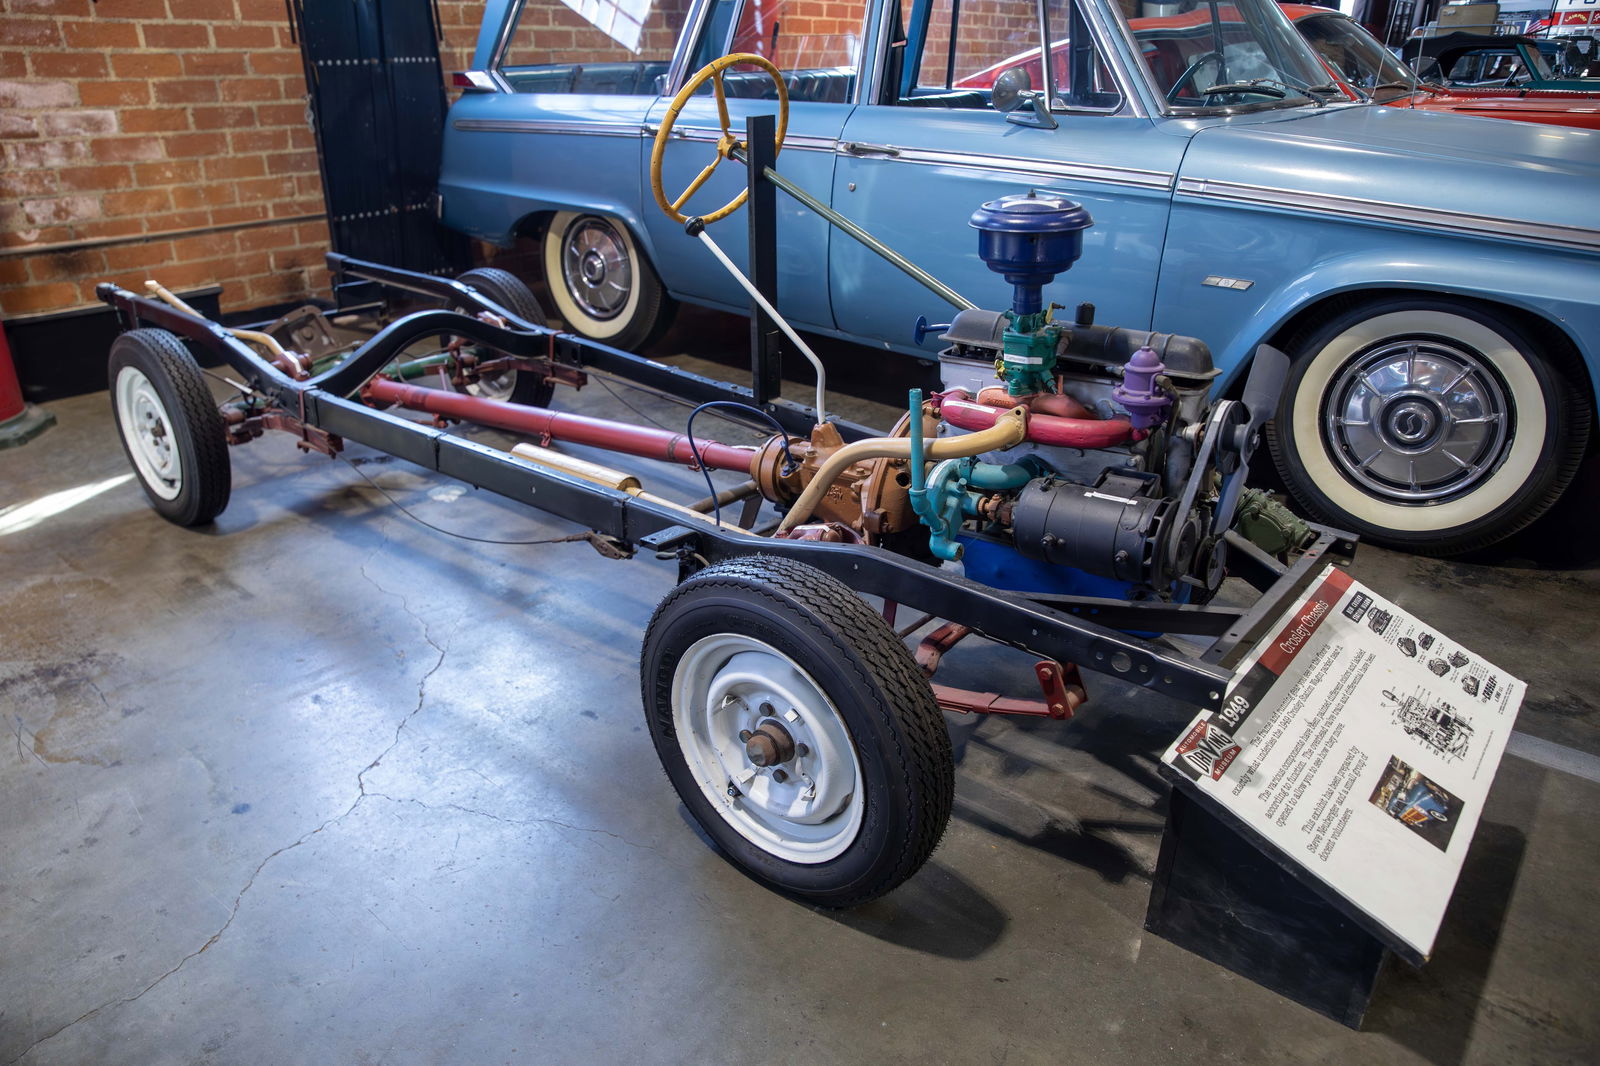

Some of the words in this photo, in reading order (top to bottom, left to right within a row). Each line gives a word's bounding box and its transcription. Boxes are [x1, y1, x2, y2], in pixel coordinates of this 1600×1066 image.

[1279, 623, 1310, 653] Crosley
[1300, 599, 1328, 627] Chassis
[1311, 656, 1321, 665] the
[1315, 647, 1327, 659] floor
[1351, 648, 1366, 664] labeled
[1302, 668, 1311, 678] see
[1347, 661, 1357, 672] and
[1296, 676, 1307, 687] you
[1339, 669, 1352, 684] colors
[1289, 683, 1300, 697] gear
[1326, 681, 1343, 701] different
[1276, 692, 1295, 714] running
[1316, 698, 1332, 720] painted
[1218, 695, 1250, 728] 1949
[1269, 710, 1280, 723] and
[1231, 773, 1251, 796] exactly
[1246, 759, 1260, 775] what
[1256, 736, 1277, 761] underlies
[1272, 728, 1283, 739] the
[1278, 715, 1291, 730] 1949
[1286, 699, 1304, 718] Crosley
[1298, 684, 1315, 702] Station
[1309, 671, 1324, 686] Wagon
[1320, 656, 1334, 674] parked
[1329, 648, 1340, 660] near
[1256, 721, 1273, 738] frame
[1306, 716, 1320, 729] been
[1179, 722, 1206, 752] AUTOMOBILE
[1249, 736, 1262, 747] The
[1264, 787, 1289, 819] according
[1301, 748, 1314, 759] The
[1309, 725, 1328, 750] overhead
[1323, 714, 1336, 727] valve
[1331, 702, 1344, 715] train
[1339, 692, 1349, 704] and
[1344, 670, 1364, 695] differential
[1358, 661, 1370, 673] have
[1365, 653, 1376, 664] been
[1298, 727, 1313, 742] have
[1324, 734, 1338, 748] they
[1186, 727, 1233, 774] DRIVING
[1281, 739, 1305, 770] components
[1317, 746, 1329, 759] how
[1214, 749, 1237, 775] MUSEUM
[1313, 757, 1323, 768] see
[1336, 751, 1355, 778] prepared
[1267, 767, 1285, 790] various
[1302, 771, 1314, 786] you
[1327, 775, 1341, 789] been
[1257, 789, 1271, 802] The
[1293, 781, 1307, 799] allow
[1321, 787, 1334, 800] has
[1306, 833, 1322, 853] Steve
[1316, 803, 1339, 836] Neuberger
[1335, 791, 1346, 805] and
[1343, 772, 1357, 791] small
[1352, 758, 1366, 777] group
[1311, 798, 1328, 820] exhibit
[1275, 802, 1293, 827] opened
[1300, 818, 1315, 834] This
[1317, 838, 1335, 861] docent
